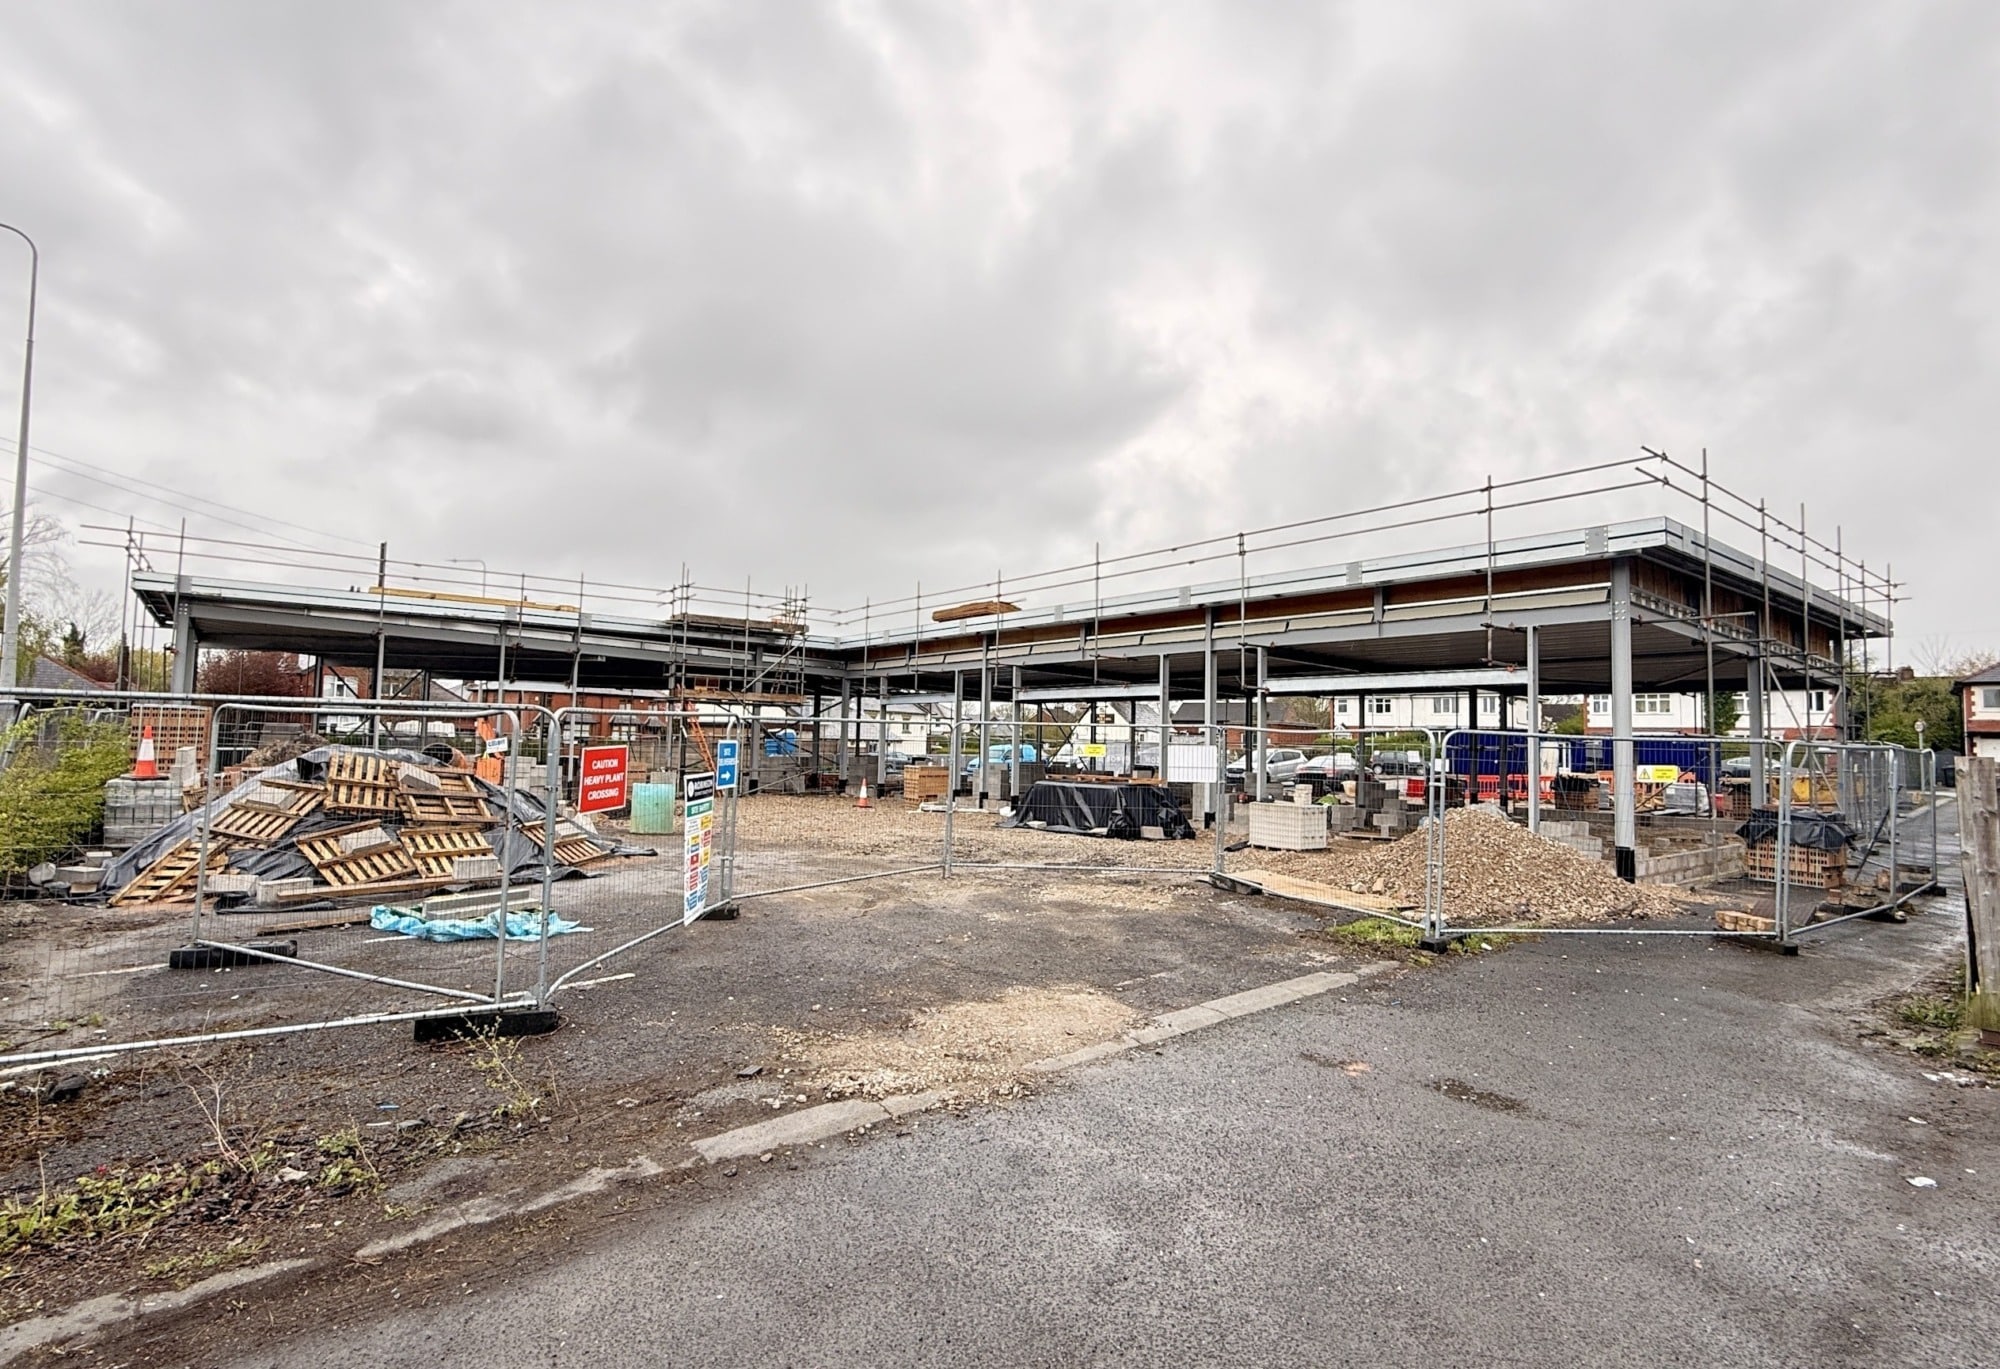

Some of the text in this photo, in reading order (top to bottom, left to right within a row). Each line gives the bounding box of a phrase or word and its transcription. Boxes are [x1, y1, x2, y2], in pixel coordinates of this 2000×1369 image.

[592, 758, 619, 770] CAUTION
[584, 772, 625, 786] HEAVY PLANT
[587, 787, 619, 801] CROSSING
